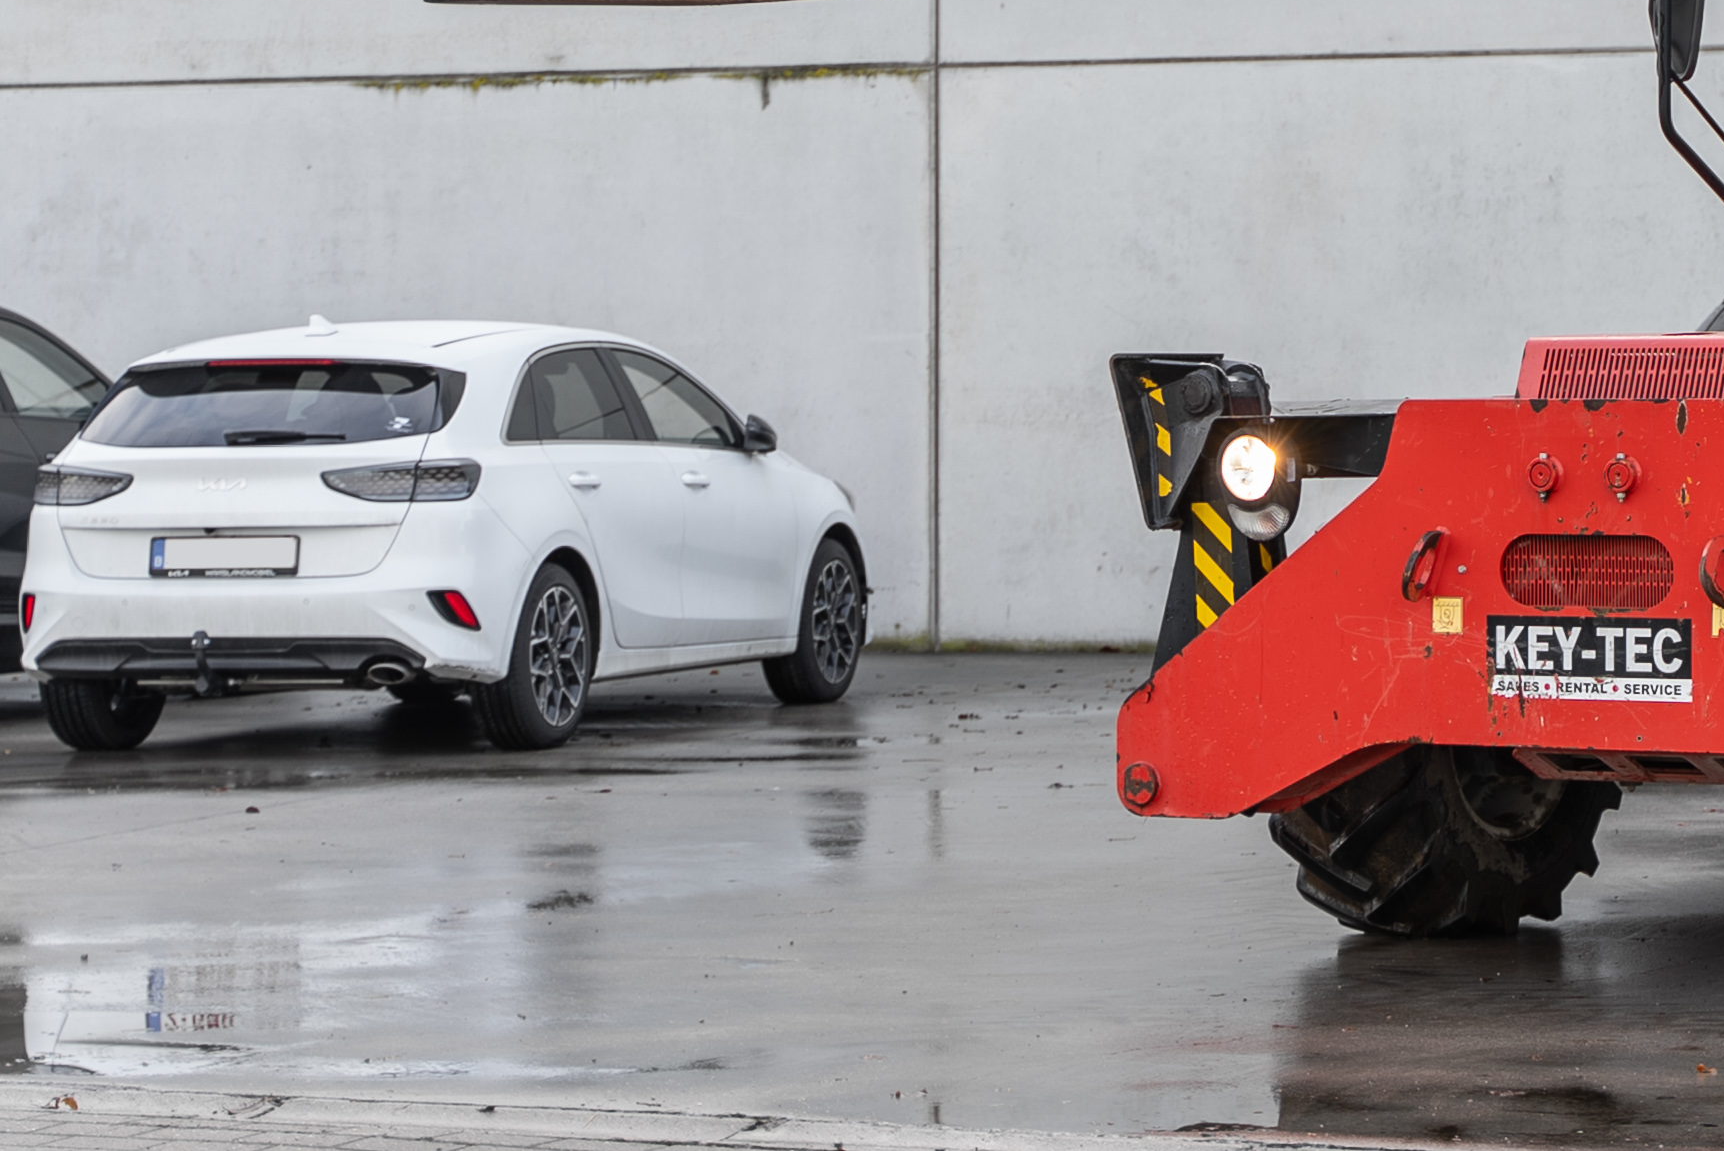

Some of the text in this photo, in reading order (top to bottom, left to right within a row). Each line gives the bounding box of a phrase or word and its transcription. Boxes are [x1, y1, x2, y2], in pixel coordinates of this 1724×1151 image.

[1495, 625, 1683, 674] KEY-TEC
[1557, 681, 1608, 694] RENTAL
[1624, 683, 1682, 696] SERVICE
